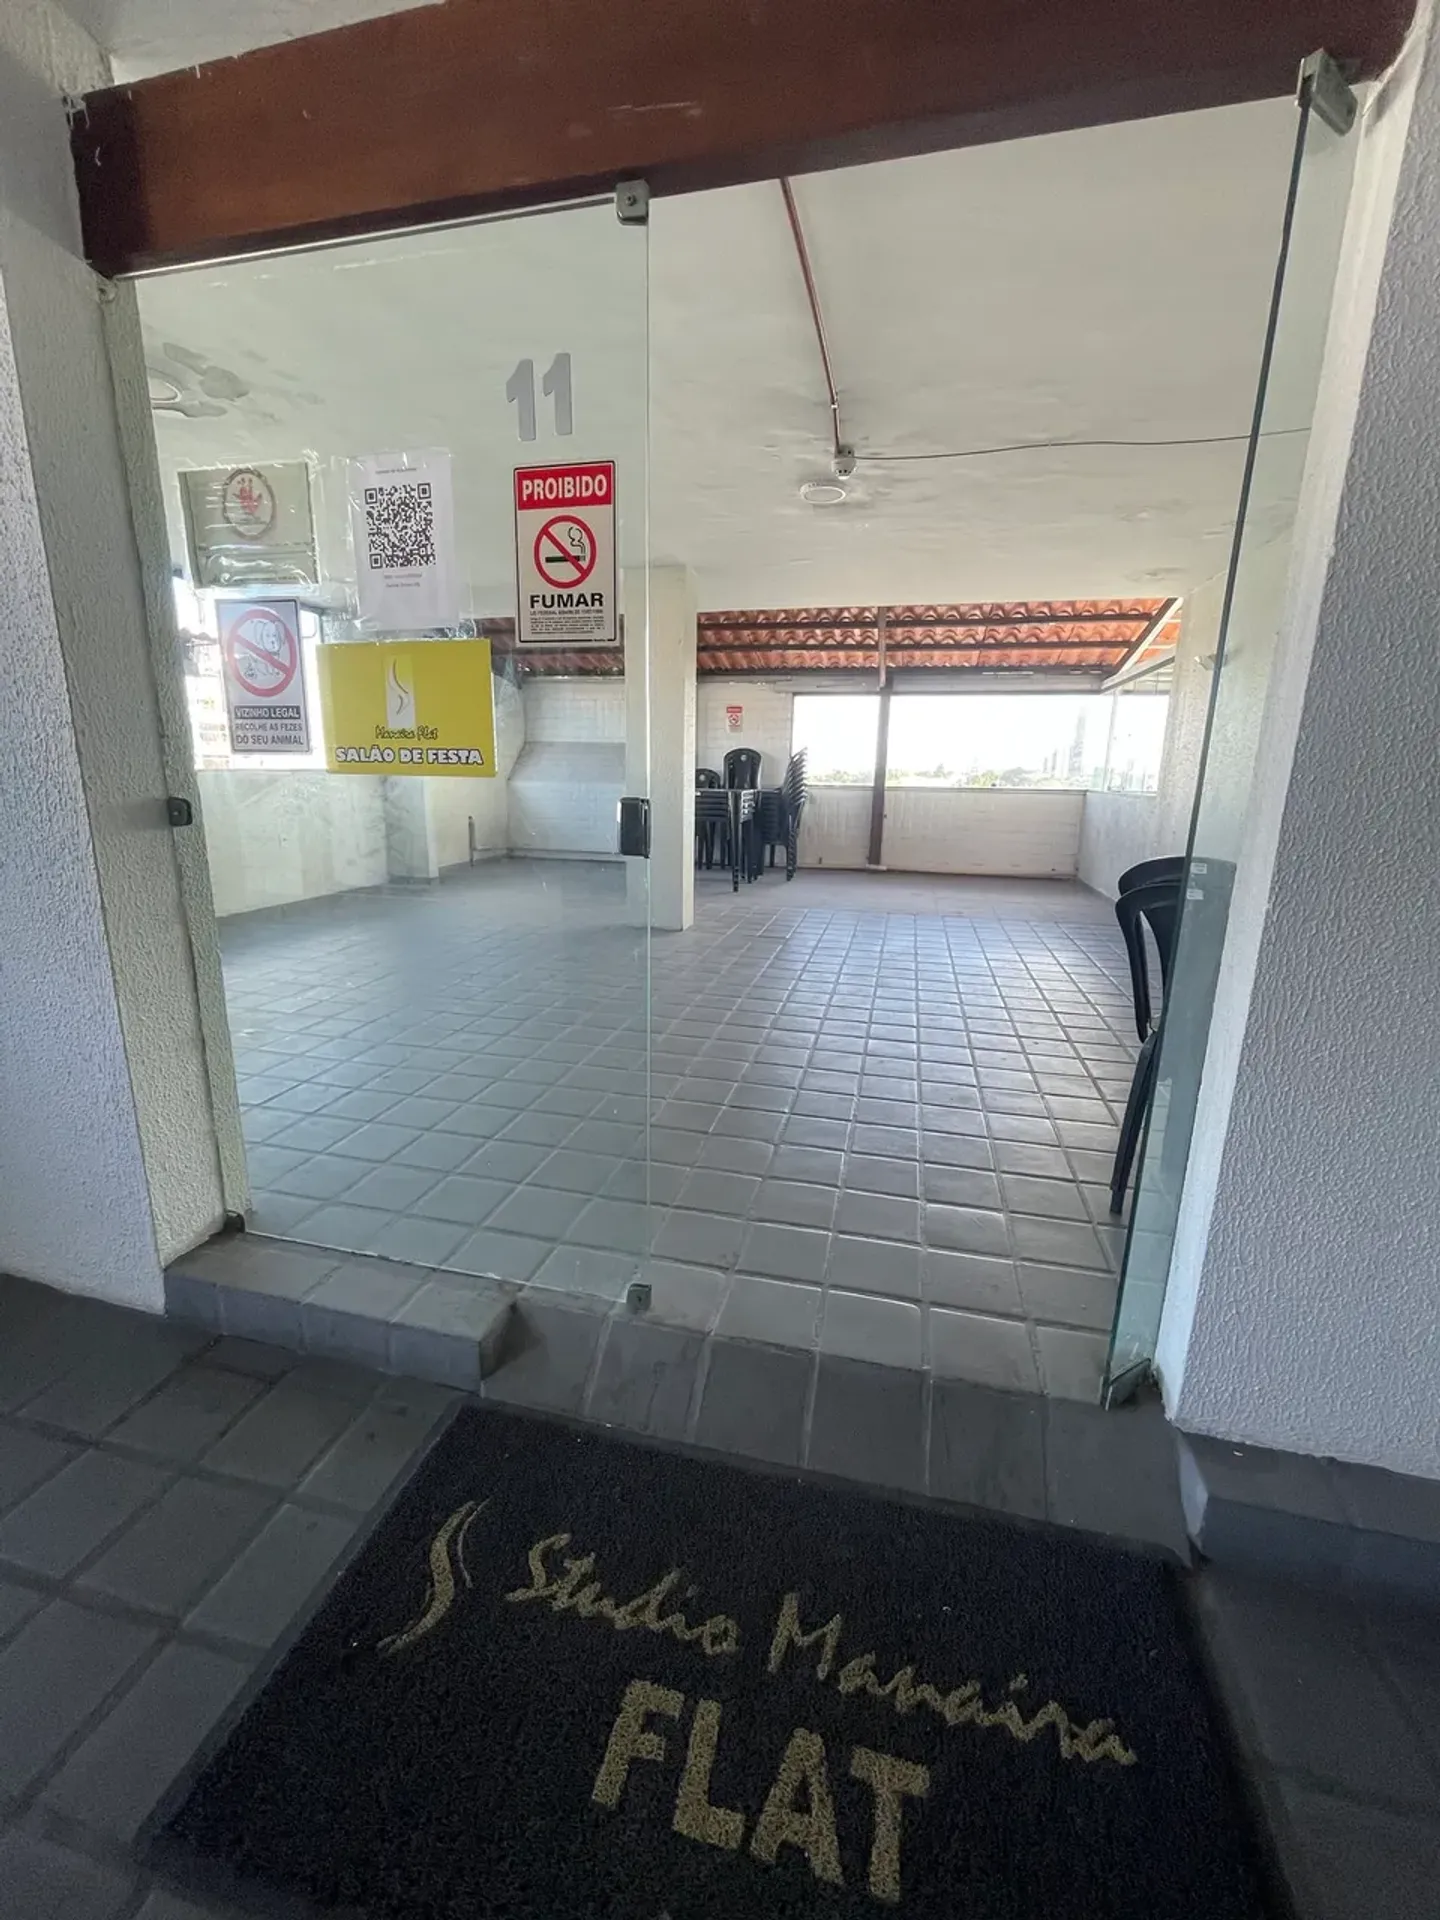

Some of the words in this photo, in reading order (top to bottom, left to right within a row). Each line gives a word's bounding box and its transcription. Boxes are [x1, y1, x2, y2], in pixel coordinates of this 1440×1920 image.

[506, 352, 573, 441] 11
[522, 474, 608, 501] PROIBIDO
[529, 592, 604, 609] FUMAR
[235, 707, 270, 718] VIZINHO
[270, 707, 300, 718] LEGAL
[235, 722, 268, 732] RECOLHE
[269, 722, 279, 732] AS
[280, 722, 303, 732] FEZES
[235, 734, 249, 745] DO
[250, 734, 269, 745] SEU
[271, 734, 304, 746] ANIMAL
[335, 744, 395, 763] SALÃO
[399, 747, 424, 764] DE
[427, 747, 484, 766] FESTA
[504, 1532, 741, 1656] Studio
[591, 1677, 931, 1906] FLAT
